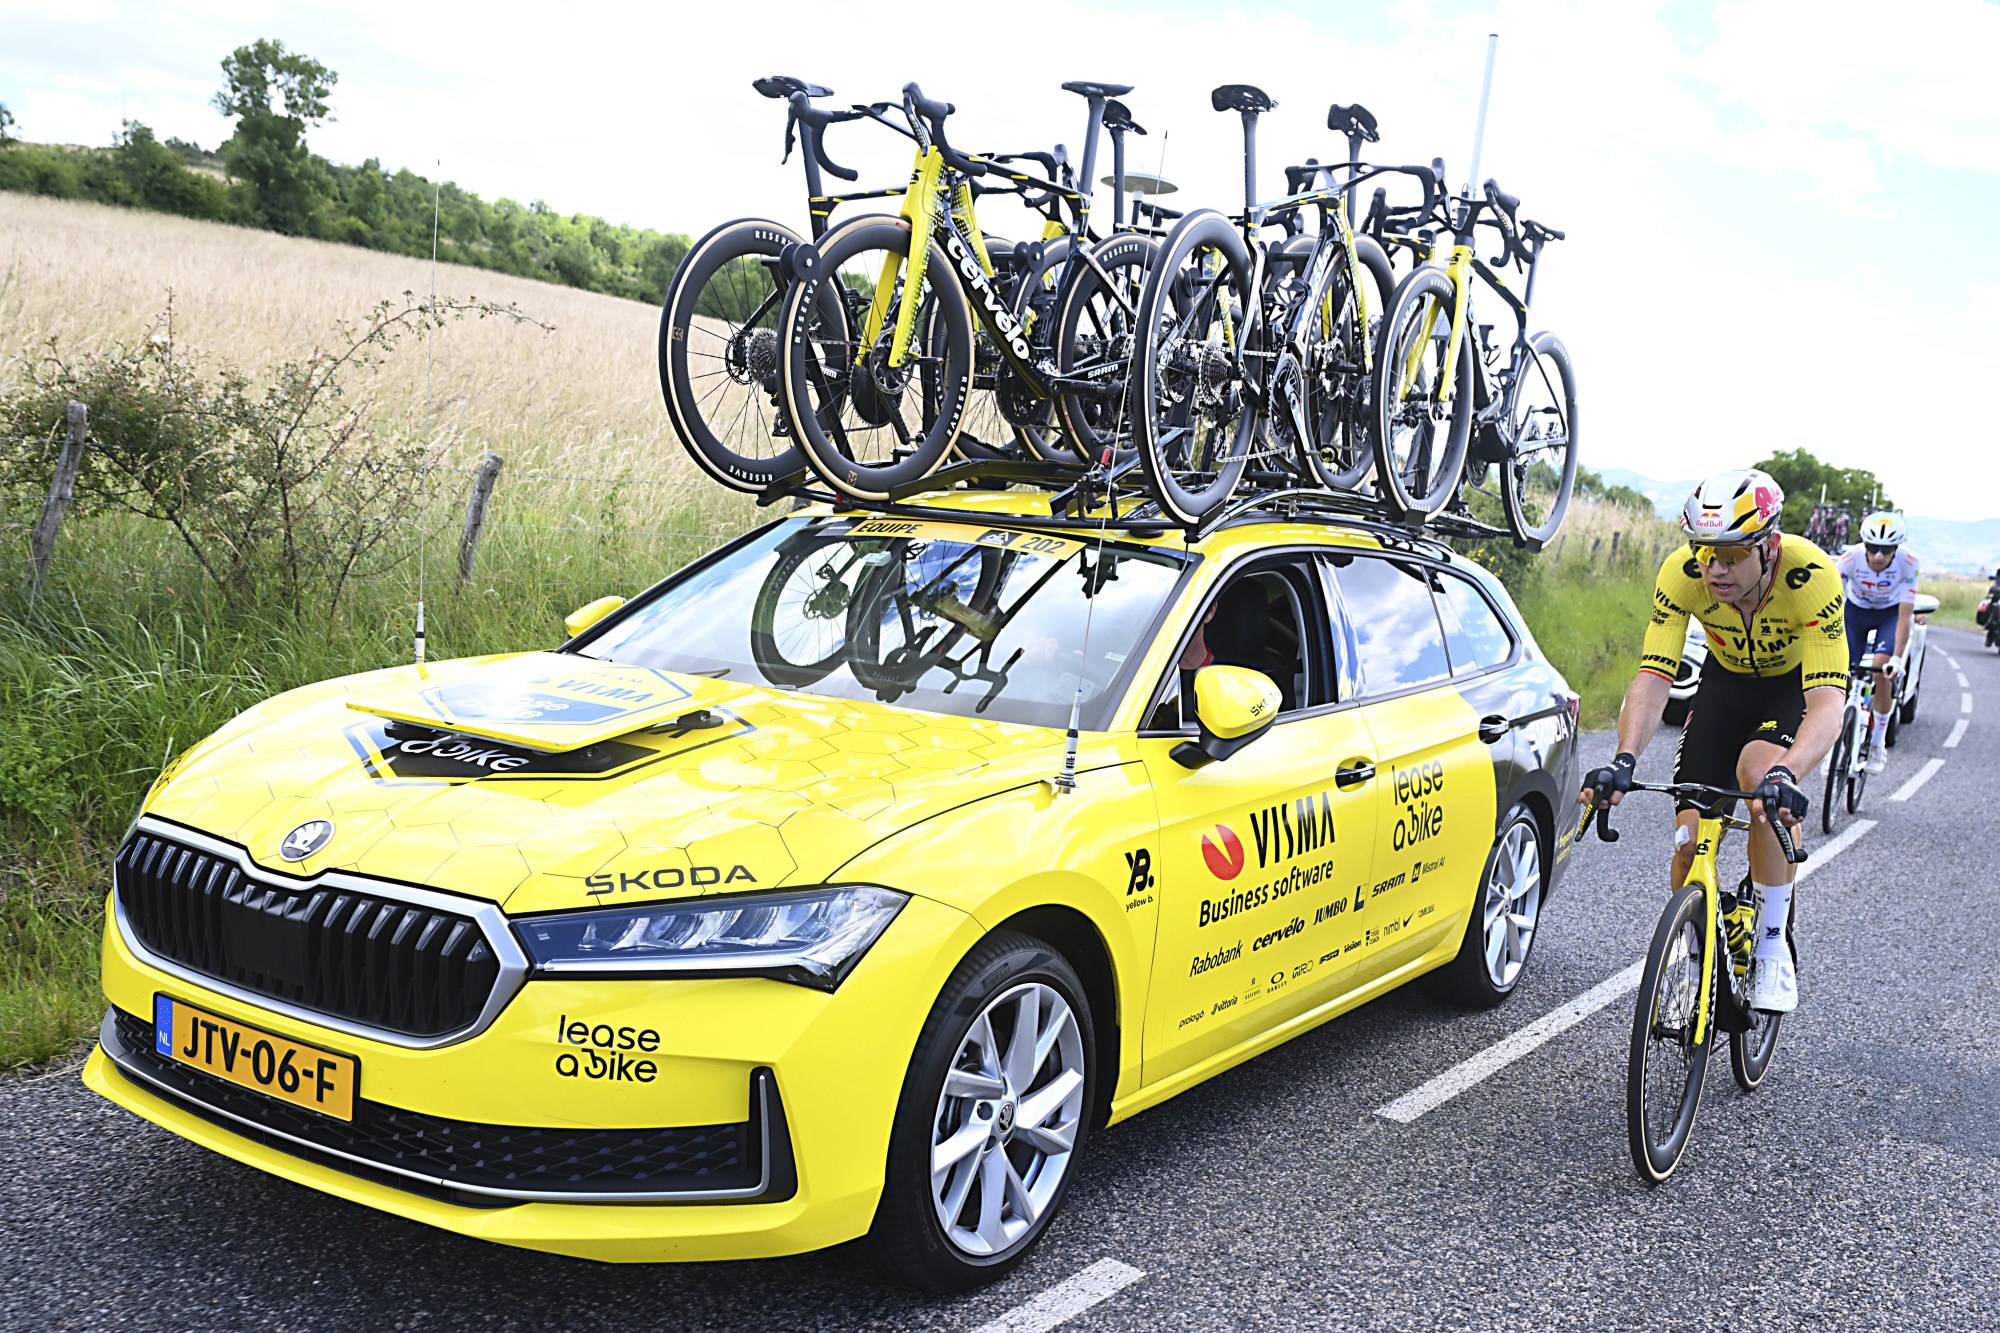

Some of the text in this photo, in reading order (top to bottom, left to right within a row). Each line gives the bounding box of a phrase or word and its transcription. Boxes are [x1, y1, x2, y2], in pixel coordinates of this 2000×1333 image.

[755, 230, 794, 245] RESERV
[1103, 243, 1139, 262] RESERVE
[947, 236, 1031, 360] cervélo
[794, 278, 820, 344] RESERVE
[1087, 363, 1119, 379] SRAM
[946, 376, 967, 437] RESERVE
[729, 464, 774, 483] RESERVE
[856, 521, 923, 534] ÉQUIPE
[1696, 519, 1723, 528] Red Bull
[1020, 536, 1066, 554] 202
[1655, 588, 1687, 616] VISMA
[1816, 591, 1844, 619] VISM
[1733, 635, 1800, 653] VISMA
[1642, 654, 1677, 668] RAM
[557, 680, 653, 703] VISMA
[1392, 760, 1443, 805] lease
[1249, 791, 1336, 869] VISMA
[1199, 860, 1334, 928] Business software
[1126, 897, 1147, 913] yellow
[1189, 939, 1243, 978] Rabobank
[1252, 916, 1306, 952] cervélo
[1313, 897, 1348, 926] JUMBO
[1371, 872, 1406, 898] SRAM
[1383, 918, 1401, 937] nimbl
[1266, 980, 1288, 994] OAKLEY
[1178, 1009, 1205, 1030] prologo
[1217, 995, 1238, 1012] vittoria
[158, 1030, 171, 1049] NL
[557, 1014, 661, 1052] lease
[183, 1016, 338, 1103] JTV-06-F
